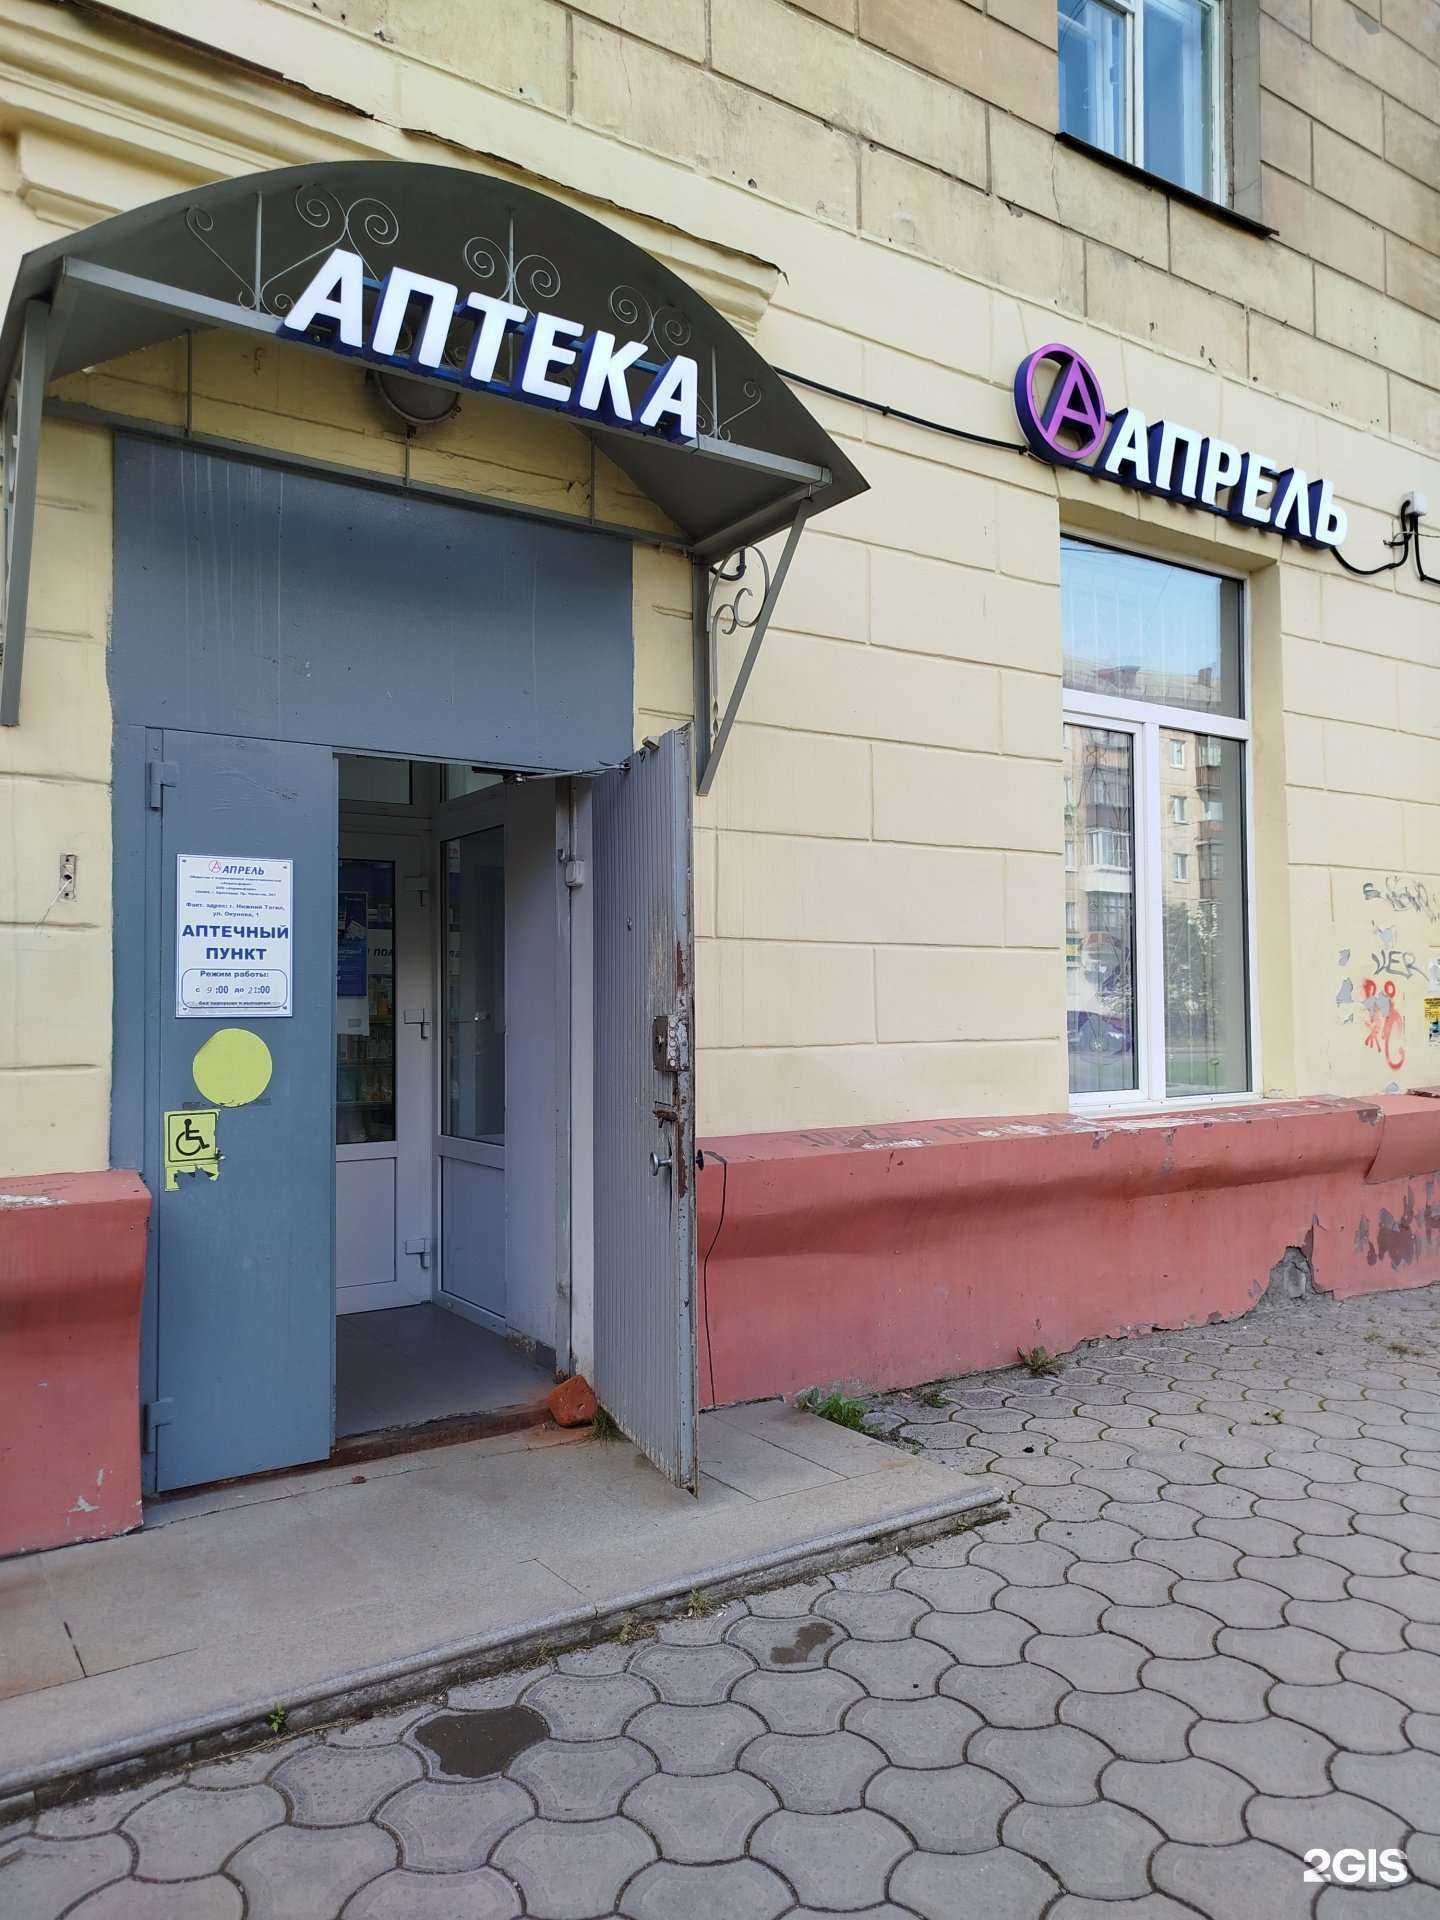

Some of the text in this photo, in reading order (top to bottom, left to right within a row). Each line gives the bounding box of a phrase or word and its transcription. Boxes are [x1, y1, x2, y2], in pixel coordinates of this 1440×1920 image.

[282, 248, 699, 438] АПТЕКА
[1104, 406, 1348, 546] АПРЕЛЬ
[222, 865, 265, 875] АПРЕЛЬ
[182, 924, 289, 939] АПТЕЧНЫЙ
[206, 947, 267, 960] ПУНКТ
